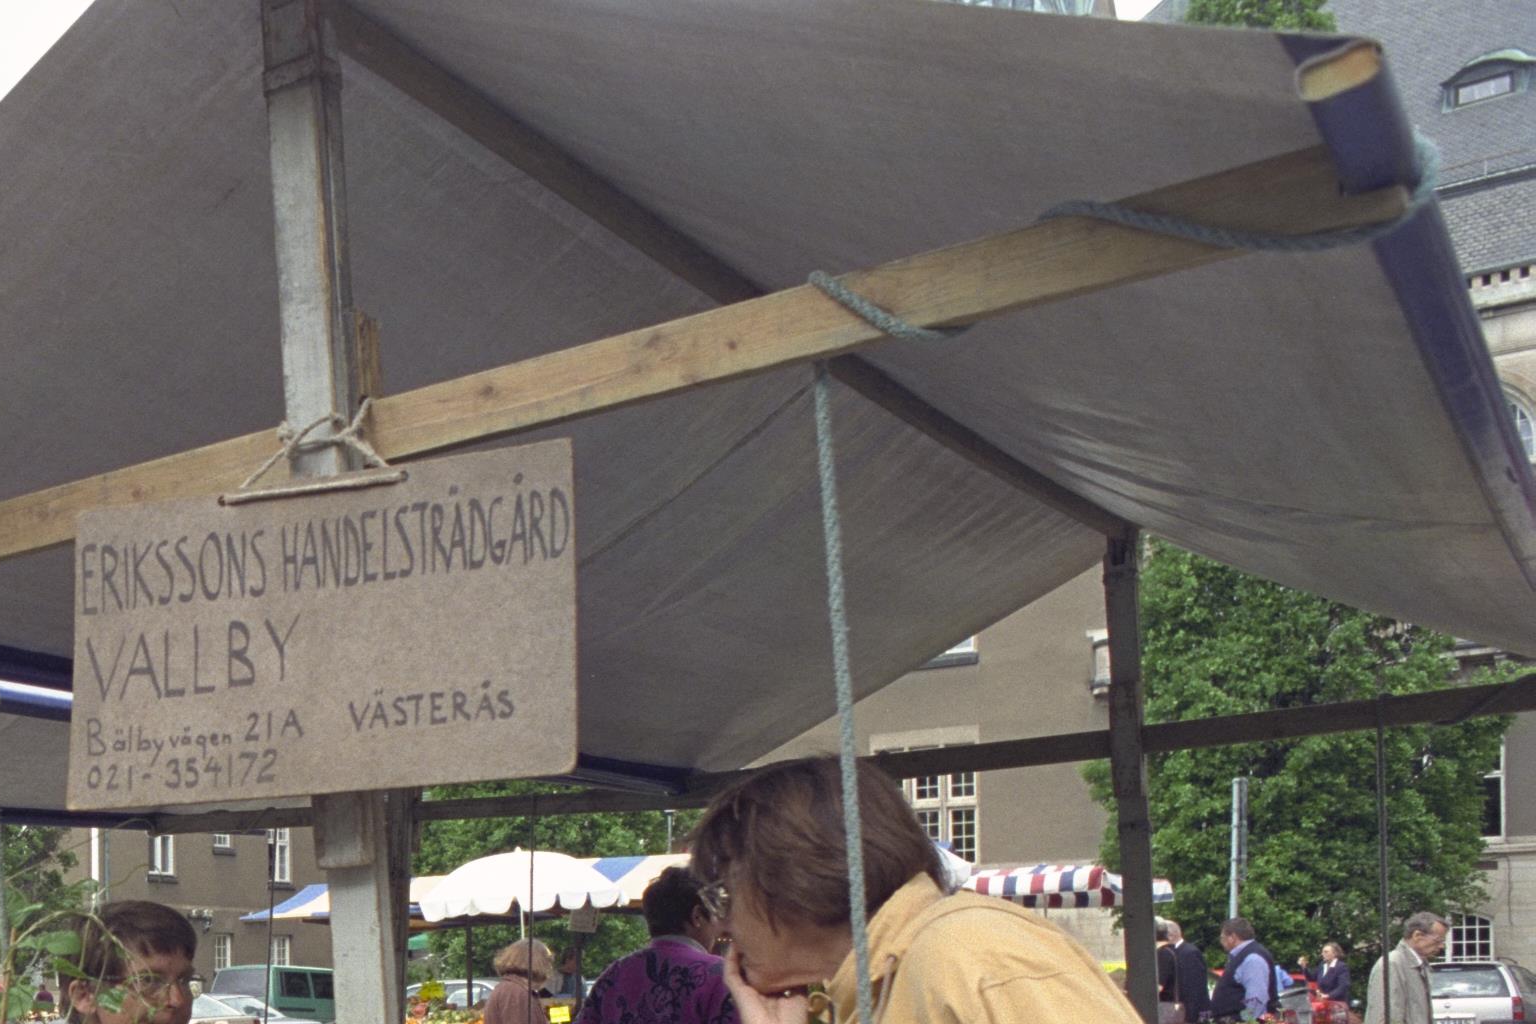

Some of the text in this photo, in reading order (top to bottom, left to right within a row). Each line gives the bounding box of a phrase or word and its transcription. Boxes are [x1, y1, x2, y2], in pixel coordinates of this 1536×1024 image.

[81, 472, 571, 616] ERIKSSONS HANDELSTRÄDGÅRD
[85, 613, 301, 702] VALLBY
[349, 680, 515, 733] VÄSTERÅS
